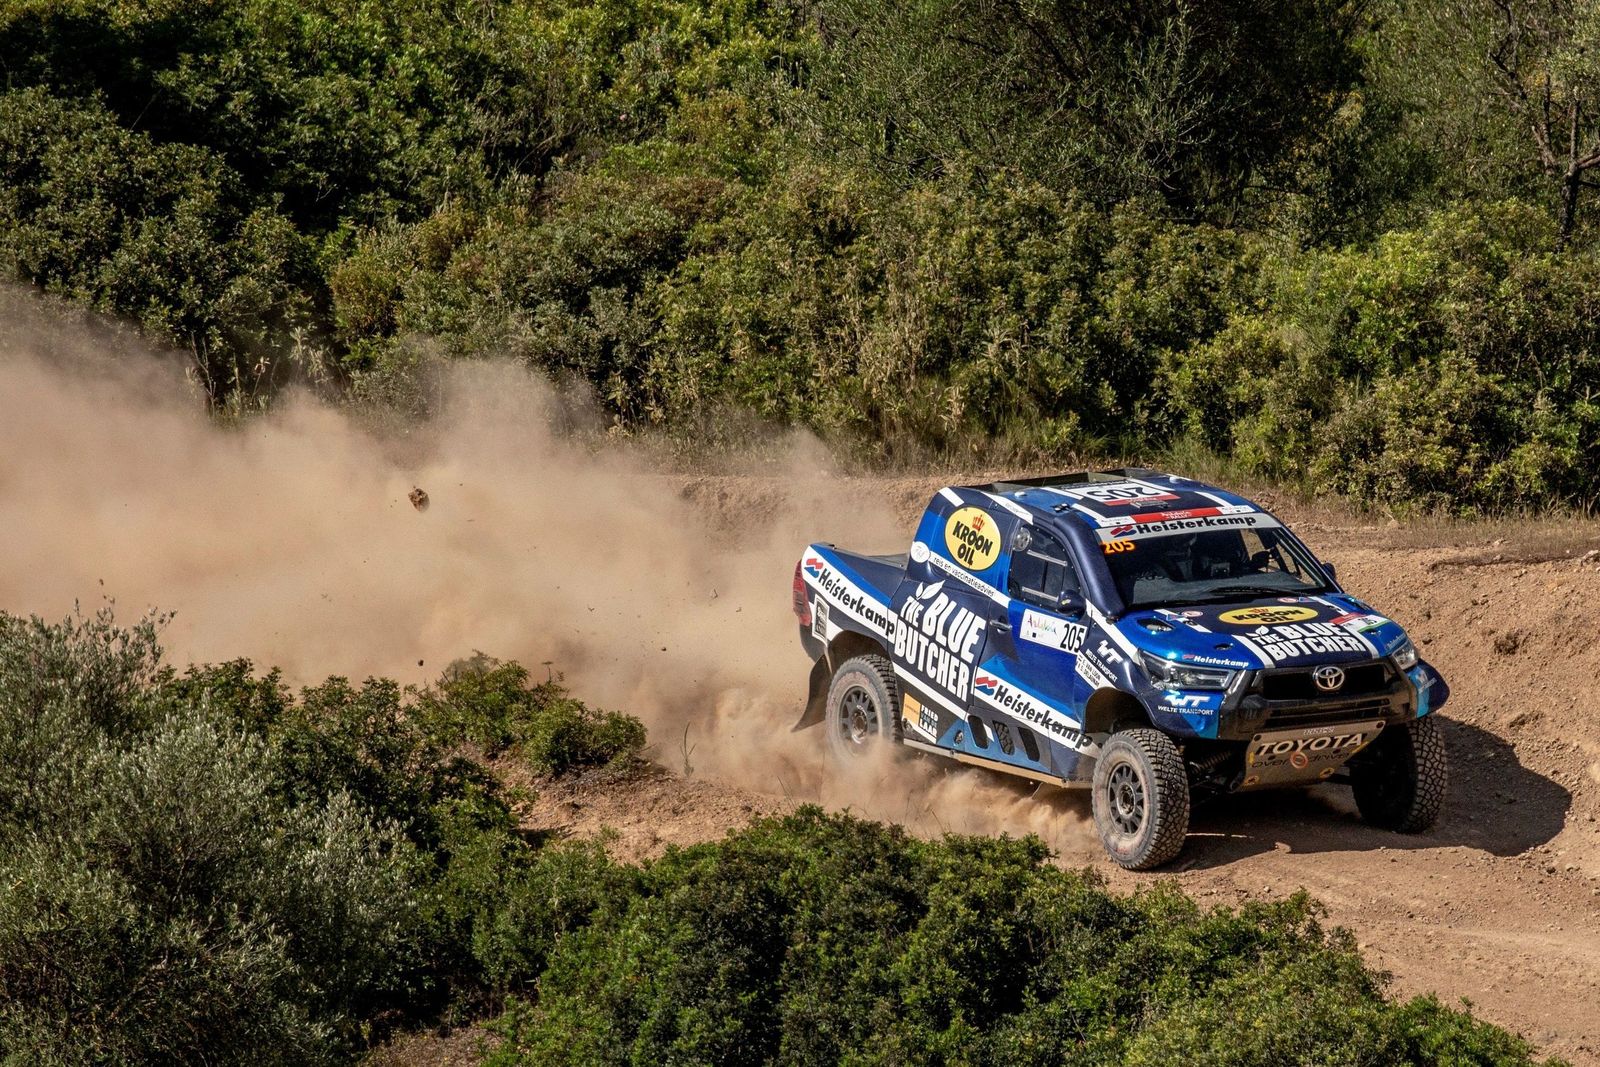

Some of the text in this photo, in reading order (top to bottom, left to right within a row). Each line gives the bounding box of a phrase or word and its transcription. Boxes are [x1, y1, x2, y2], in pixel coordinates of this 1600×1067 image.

[1087, 487, 1160, 500] 205
[1136, 515, 1256, 534] Heisterkamp
[952, 521, 993, 556] KROON
[1103, 540, 1135, 554] 205
[957, 543, 975, 566] OIL
[818, 568, 895, 636] Heisterkamp
[1232, 610, 1305, 620] KROON
[901, 592, 987, 664] THE BLUE
[1060, 624, 1085, 653] 205
[1252, 622, 1350, 646] THE BLUE
[1263, 636, 1367, 661] BUTCHER
[894, 619, 970, 702] BUTCHER
[1096, 659, 1118, 682] TRANSPORT
[1193, 656, 1249, 668] Heisterkamp
[921, 704, 938, 722] FRIED
[994, 685, 1093, 749] Heisterkamp
[1157, 705, 1214, 715] WELTE TRANSPORT
[919, 718, 938, 738] LAAR
[1256, 733, 1368, 756] TOYOTA
[1251, 757, 1289, 768] over
